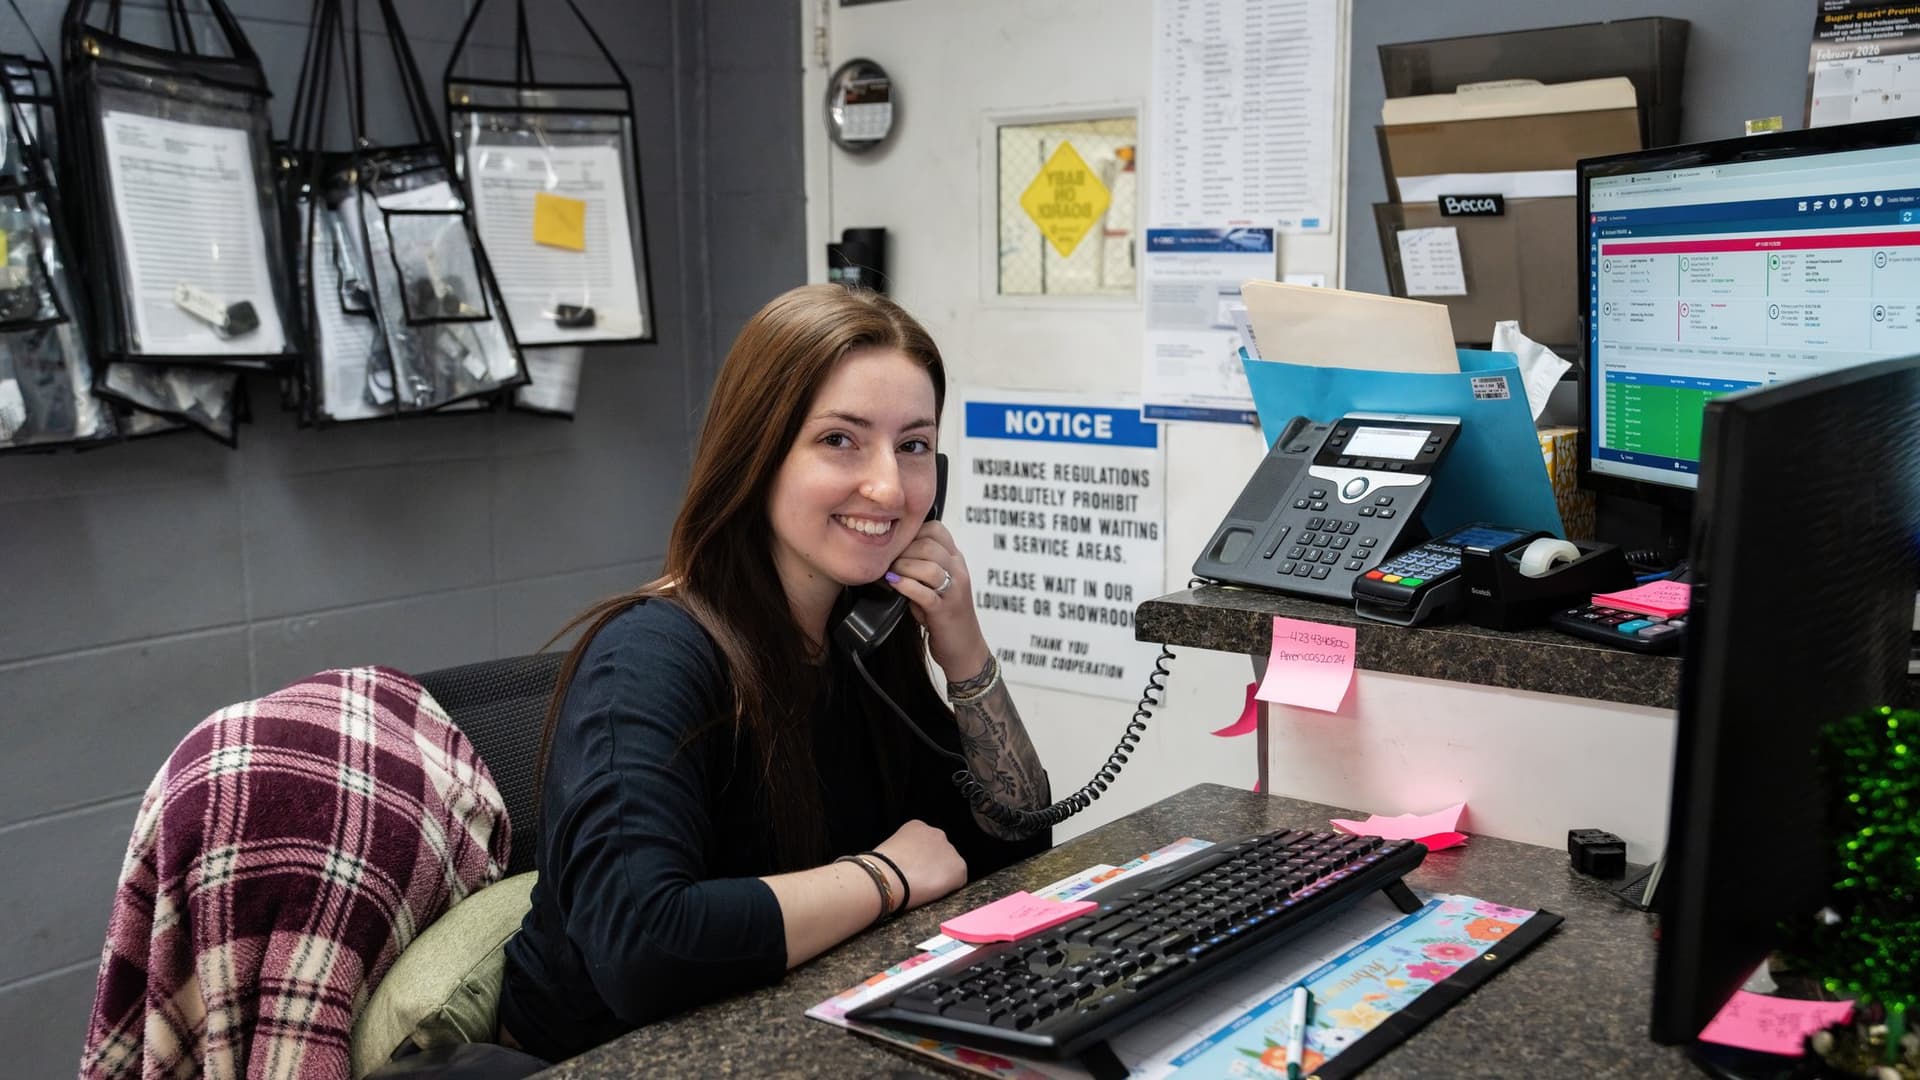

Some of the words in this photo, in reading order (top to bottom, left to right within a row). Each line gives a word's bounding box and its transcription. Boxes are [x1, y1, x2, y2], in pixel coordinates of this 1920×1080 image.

[1824, 13, 1854, 22] Super
[1817, 48, 1854, 60] February
[1856, 45, 1880, 57] 2026
[1444, 197, 1496, 214] Becca
[1005, 410, 1112, 438] NOTICE
[973, 458, 1047, 481] INSURANCE
[1054, 464, 1150, 488] REGULATIONS
[983, 484, 1066, 508] ABSOLUTELY
[1073, 492, 1138, 513] PROHIBIT
[966, 506, 1046, 530] CUSTOMERS
[1053, 514, 1091, 534] FROM
[1099, 519, 1158, 541] WAITING
[994, 534, 1006, 550] IN
[1013, 535, 1068, 558] SERVICE
[1076, 542, 1126, 564] AREAS.
[988, 568, 1036, 591] PLEASE
[1043, 574, 1076, 595] WAIT
[1084, 580, 1097, 598] IN
[1104, 582, 1134, 602] OUR
[976, 592, 1027, 615] LOUNGE
[1033, 598, 1051, 617] OR
[1030, 634, 1062, 651] THANK
[1068, 639, 1090, 656] YOU
[1020, 652, 1047, 668] YOUR
[1052, 656, 1124, 680] COOPERATION
